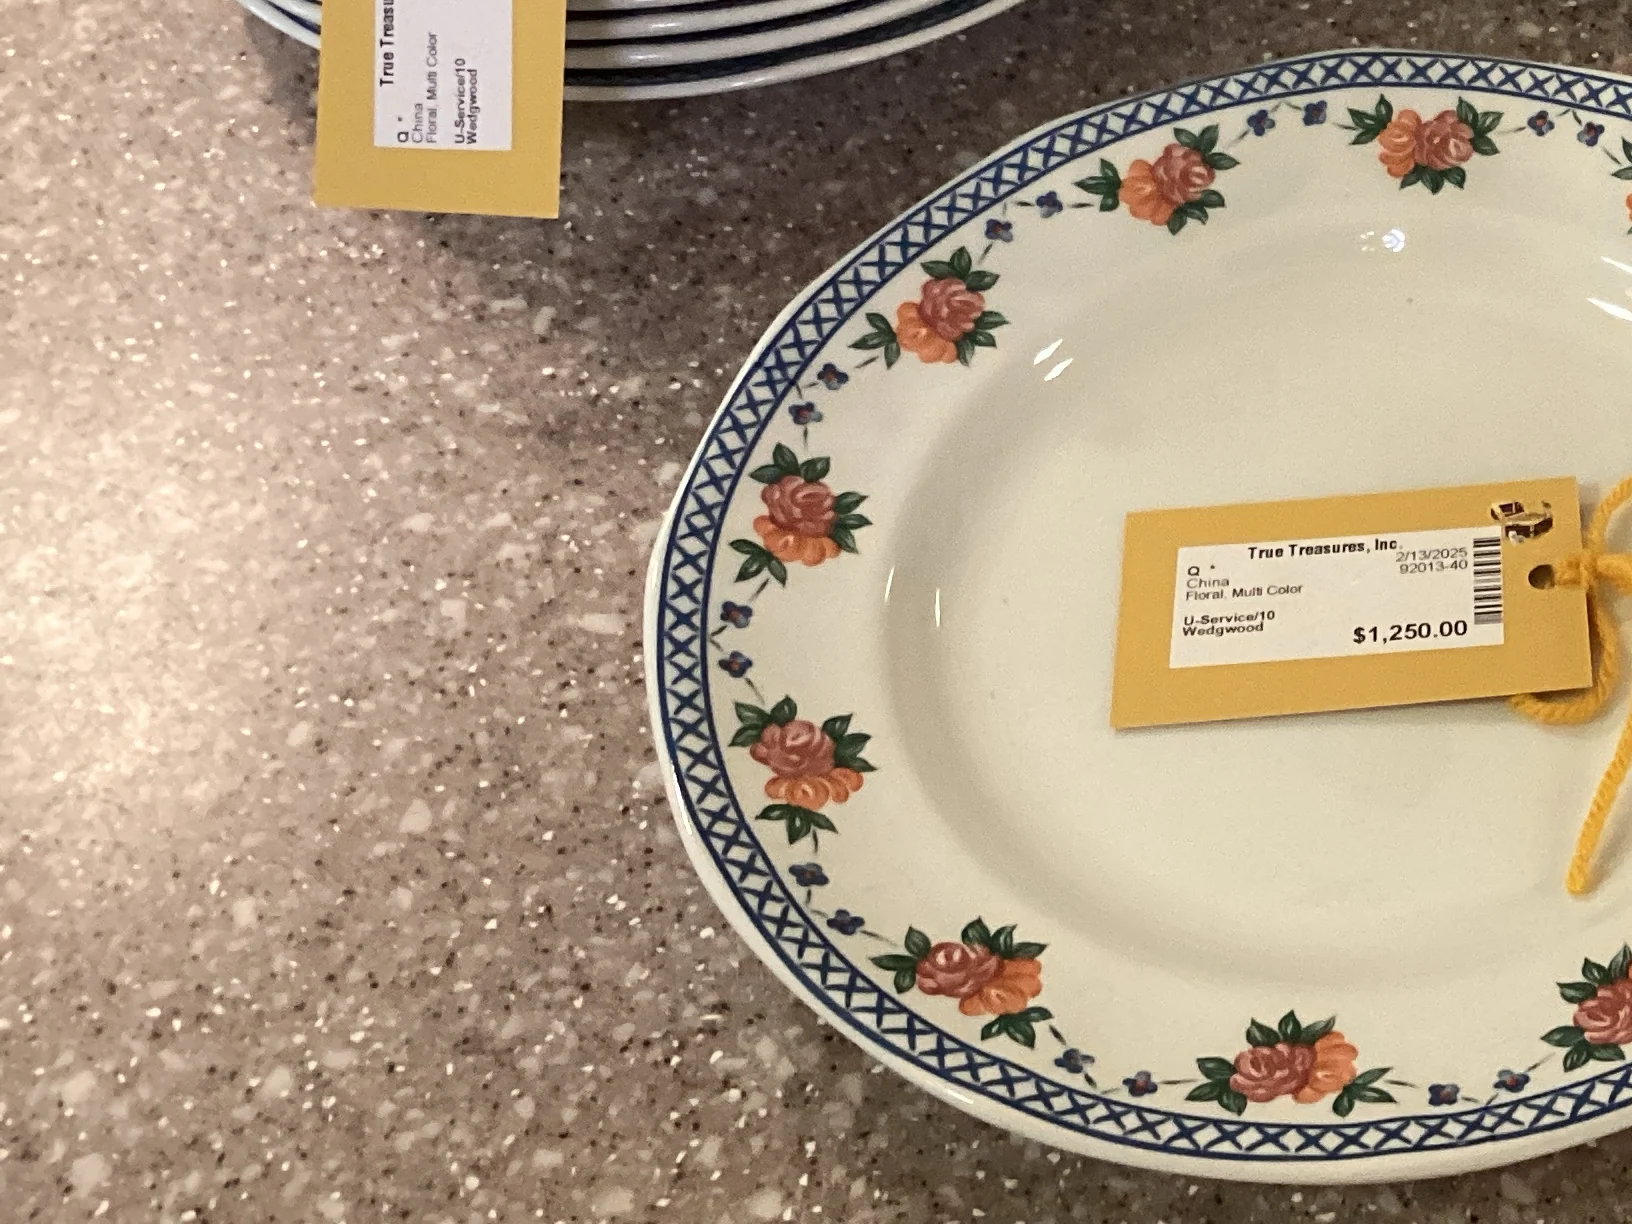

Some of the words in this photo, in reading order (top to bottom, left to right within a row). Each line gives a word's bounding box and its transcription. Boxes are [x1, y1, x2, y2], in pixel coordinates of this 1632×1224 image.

[426, 31, 438, 68] Color
[379, 52, 395, 87] True
[426, 70, 438, 101] Multi
[454, 57, 467, 144] U-Service/10
[466, 68, 481, 145] Wedgwood
[411, 103, 424, 144] China
[396, 131, 409, 144] Q
[1248, 546, 1284, 560] True
[1288, 541, 1371, 557] Treasures,
[1374, 538, 1403, 551] Inc.
[1396, 547, 1468, 563] 2/13/2025
[1187, 565, 1200, 577] Q
[1399, 559, 1468, 575] 92013-40
[1186, 577, 1230, 589] China
[1232, 587, 1263, 598] Multi
[1266, 584, 1304, 596] Color
[1183, 610, 1276, 626] U-Service/10
[1182, 622, 1264, 637] Wedgwood
[1352, 620, 1468, 644] $1,250.00
